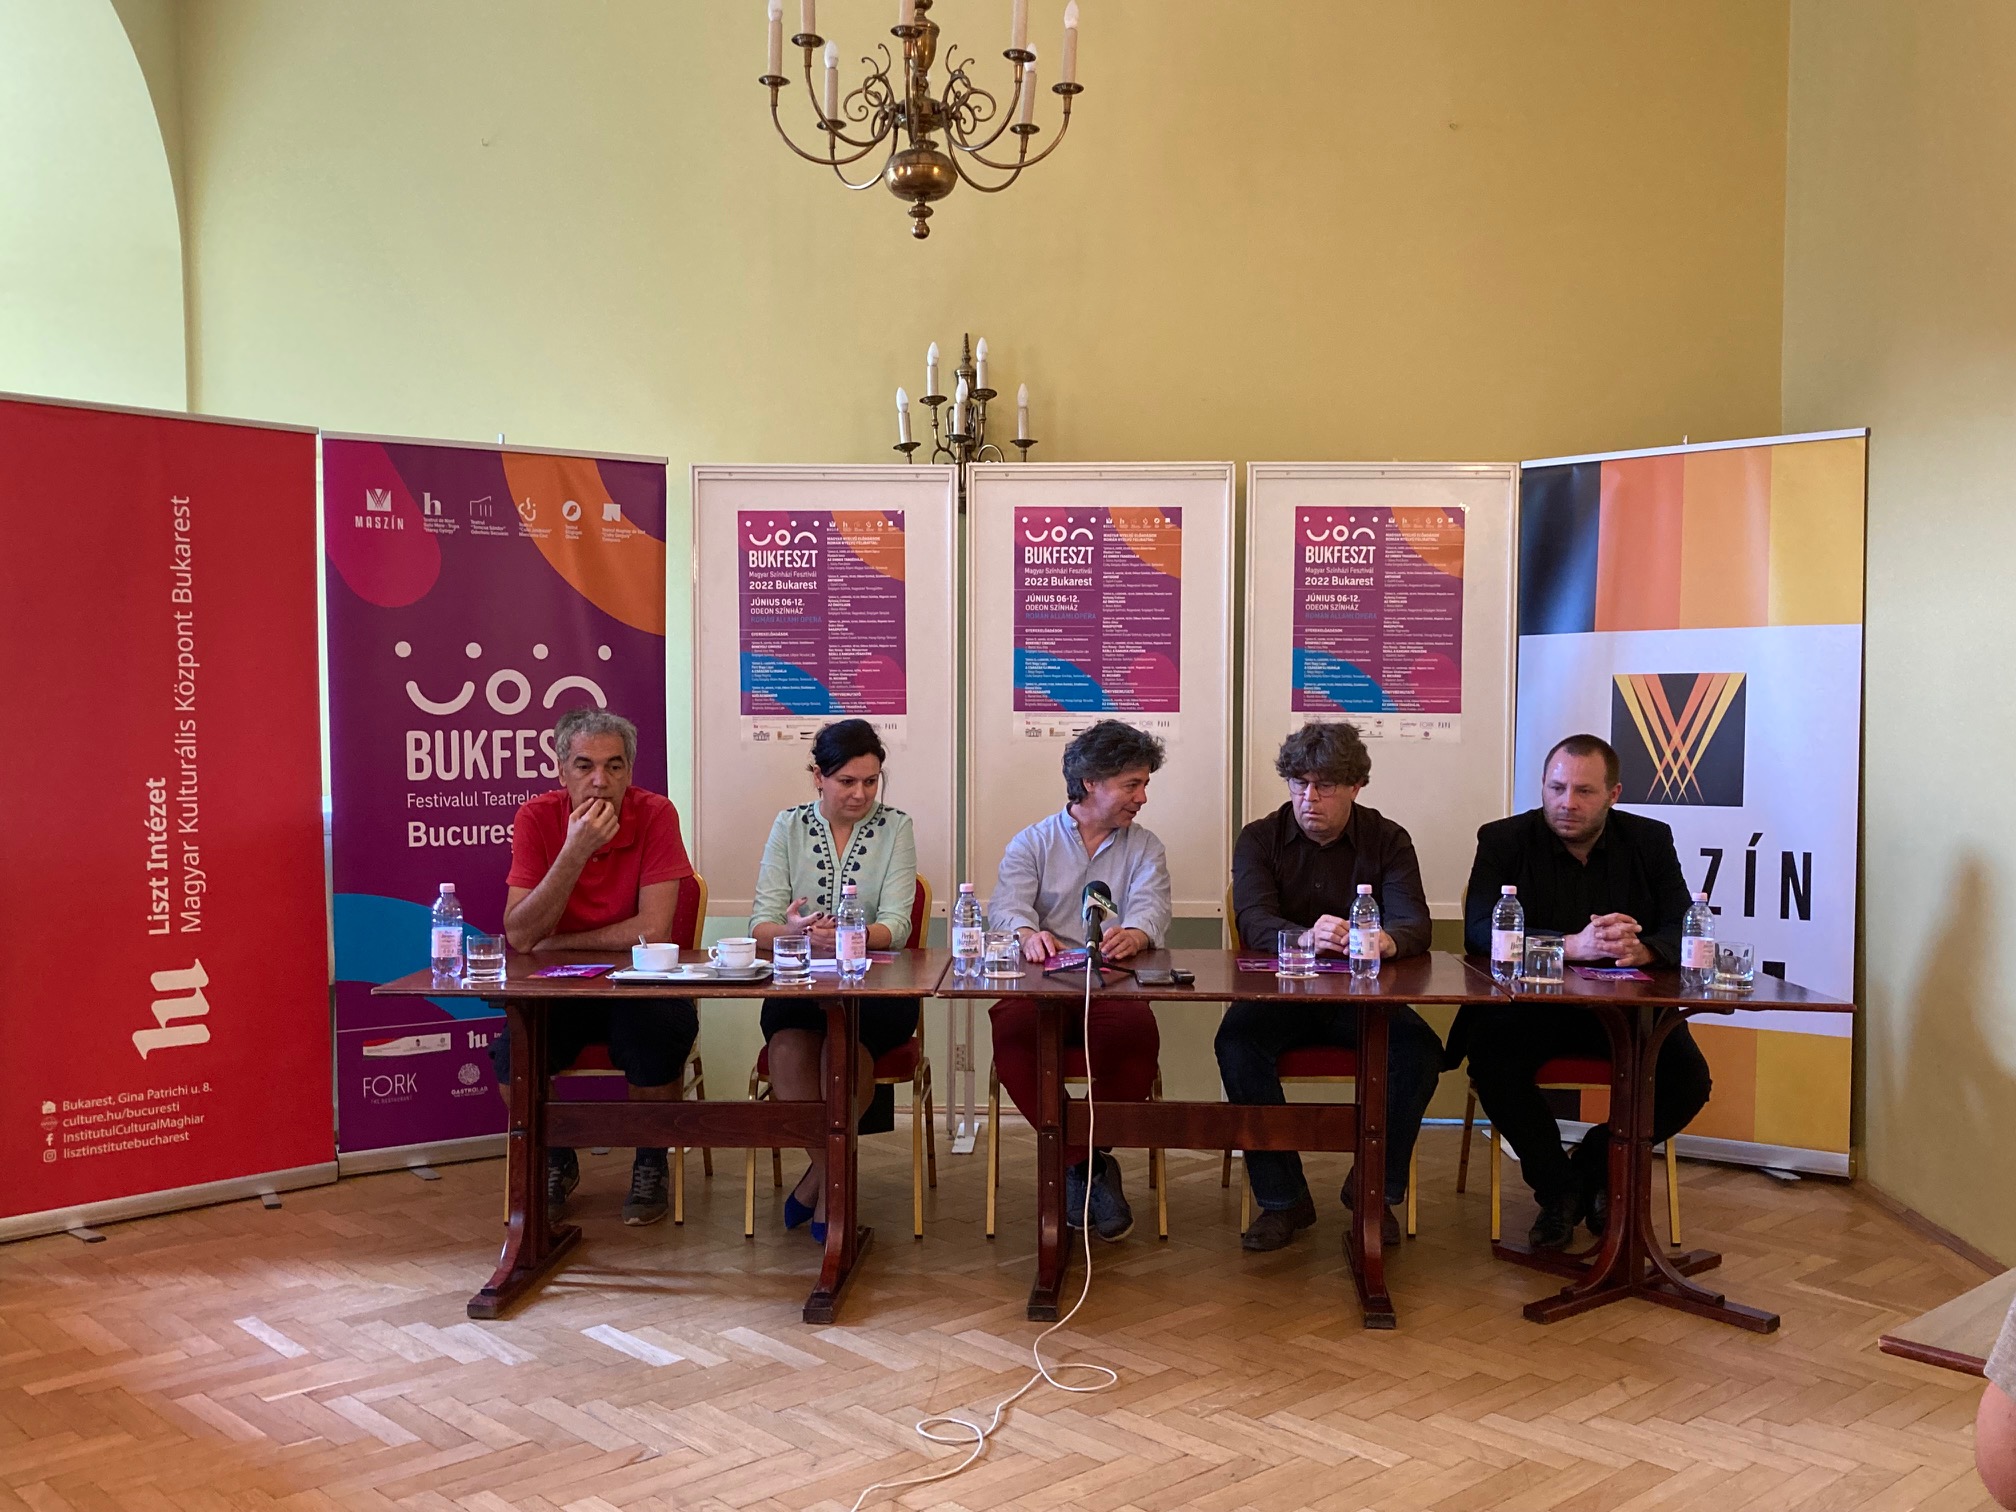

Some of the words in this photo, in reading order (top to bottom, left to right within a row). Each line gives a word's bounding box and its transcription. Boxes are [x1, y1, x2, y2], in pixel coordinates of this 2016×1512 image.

[355, 515, 404, 530] MASZÍN
[170, 496, 193, 604] Bukarest
[1025, 547, 1094, 564] BUKFESZT
[1306, 546, 1376, 564] BUKFESZT
[749, 550, 818, 568] BUKFESZT
[749, 571, 769, 579] Magyar
[793, 570, 817, 578] Fesztivál
[1305, 567, 1325, 575] Magyar
[1326, 566, 1349, 574] Színházi
[1350, 566, 1374, 574] Fesztivál
[749, 581, 774, 590] 2022
[776, 580, 817, 590] Bukarest
[1025, 578, 1049, 586] 2022
[1051, 577, 1092, 586] Bukarest
[1305, 577, 1329, 586] 2022
[1332, 576, 1374, 586] Bukarest
[751, 598, 780, 606] JÚNIUS
[1026, 594, 1055, 602] JÚNIUS
[1306, 593, 1335, 602] JÚNIUS
[775, 607, 803, 615] SZÍNHÁZ
[1050, 603, 1078, 611] SZÍNHÁZ
[1330, 603, 1359, 611] SZÍNHÁZ
[174, 610, 201, 711] Központ
[174, 719, 199, 834] Kulturális
[407, 791, 478, 808] Festivalul
[143, 777, 169, 871] Intézet
[181, 840, 207, 933] Magyar
[146, 876, 170, 936] Liszt
[363, 1072, 418, 1098] FORK
[63, 1095, 116, 1112] Bukarest,
[118, 1092, 144, 1104] Gina
[147, 1085, 188, 1100] Patrichi
[203, 1082, 212, 1092] 8.
[63, 1101, 180, 1127] culture.hu/bucuresti
[63, 1114, 205, 1143] InstitutulCulturalMaghiar
[63, 1131, 190, 1159] lisztinstitutebucharest
